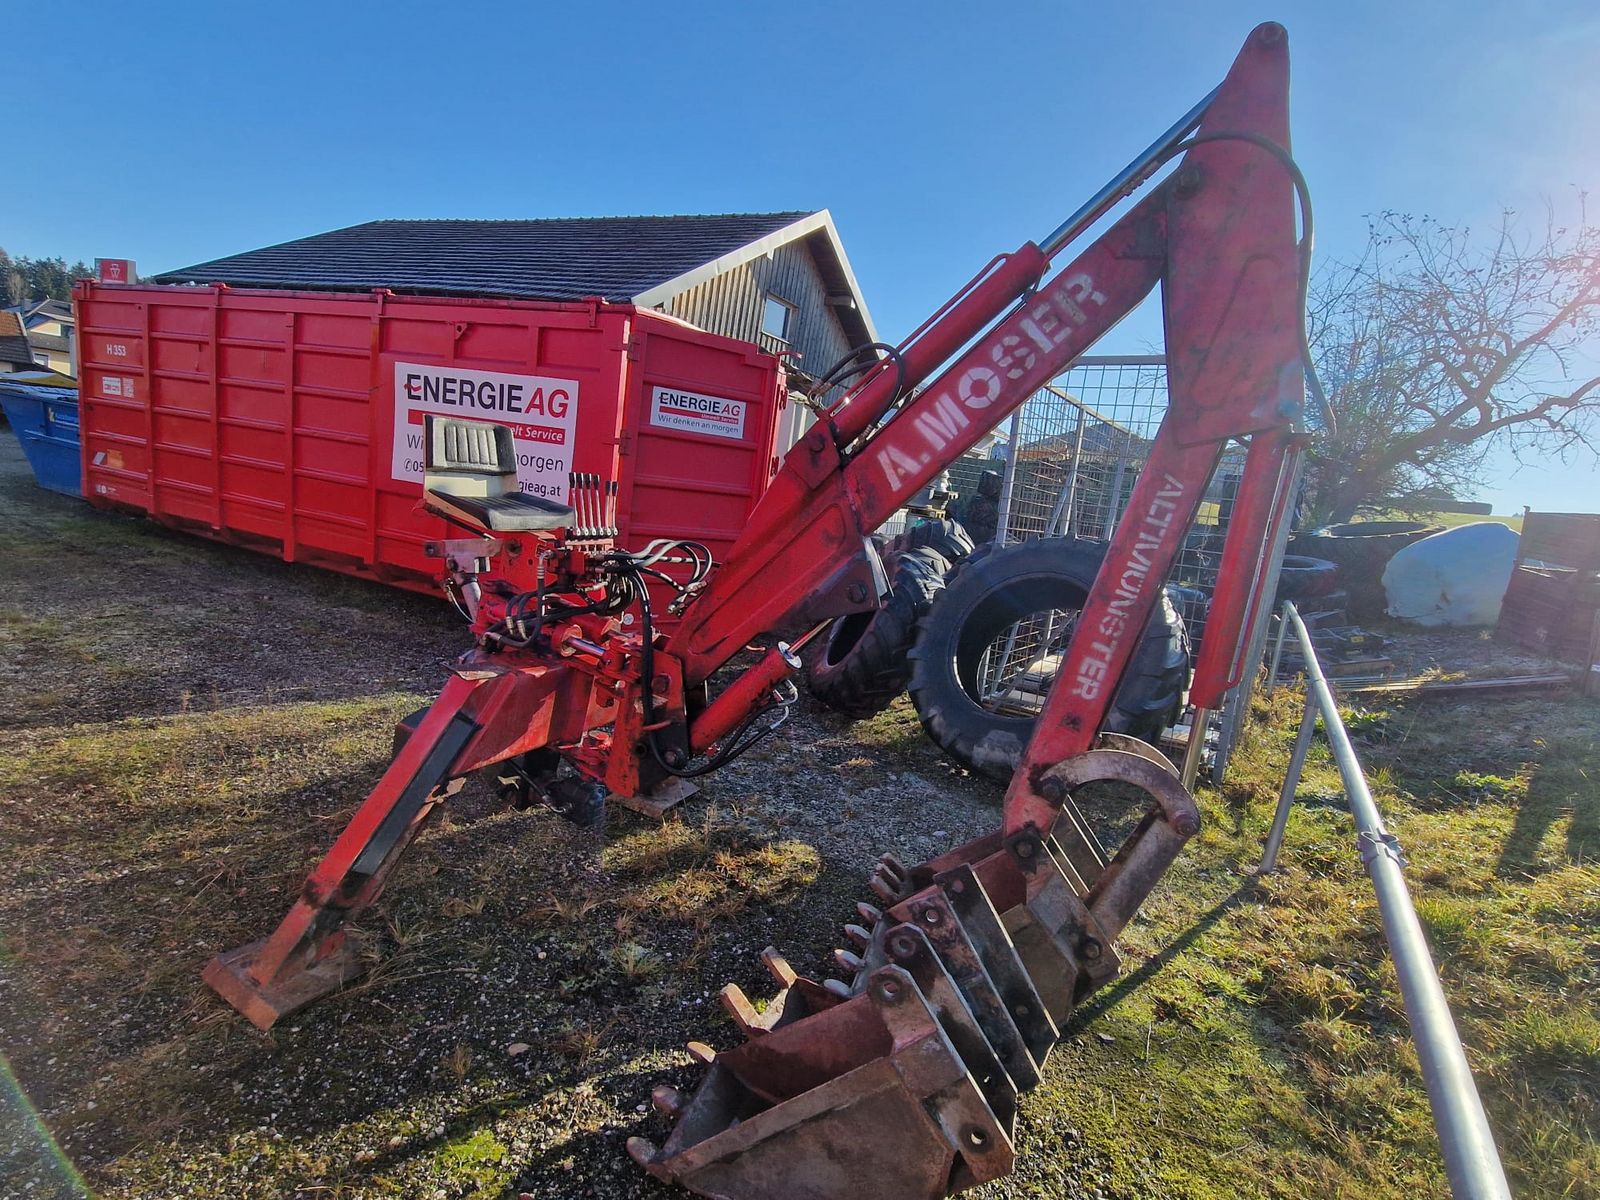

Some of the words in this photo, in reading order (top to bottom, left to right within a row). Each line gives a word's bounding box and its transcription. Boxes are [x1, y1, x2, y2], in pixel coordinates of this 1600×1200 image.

[106, 343, 113, 355] H
[113, 344, 127, 357] 353
[404, 373, 523, 413] ENERGIE
[524, 387, 569, 418] AG
[659, 392, 721, 413] ENERGIE
[721, 403, 741, 417] AG
[525, 426, 563, 442] Service
[657, 414, 671, 423] Wir
[673, 416, 700, 427] denken
[701, 422, 711, 430] an
[711, 424, 739, 434] morgen
[407, 433, 424, 450] Wi
[519, 478, 562, 498] gieag.at
[1072, 473, 1185, 701] ALTMÜNSTER
